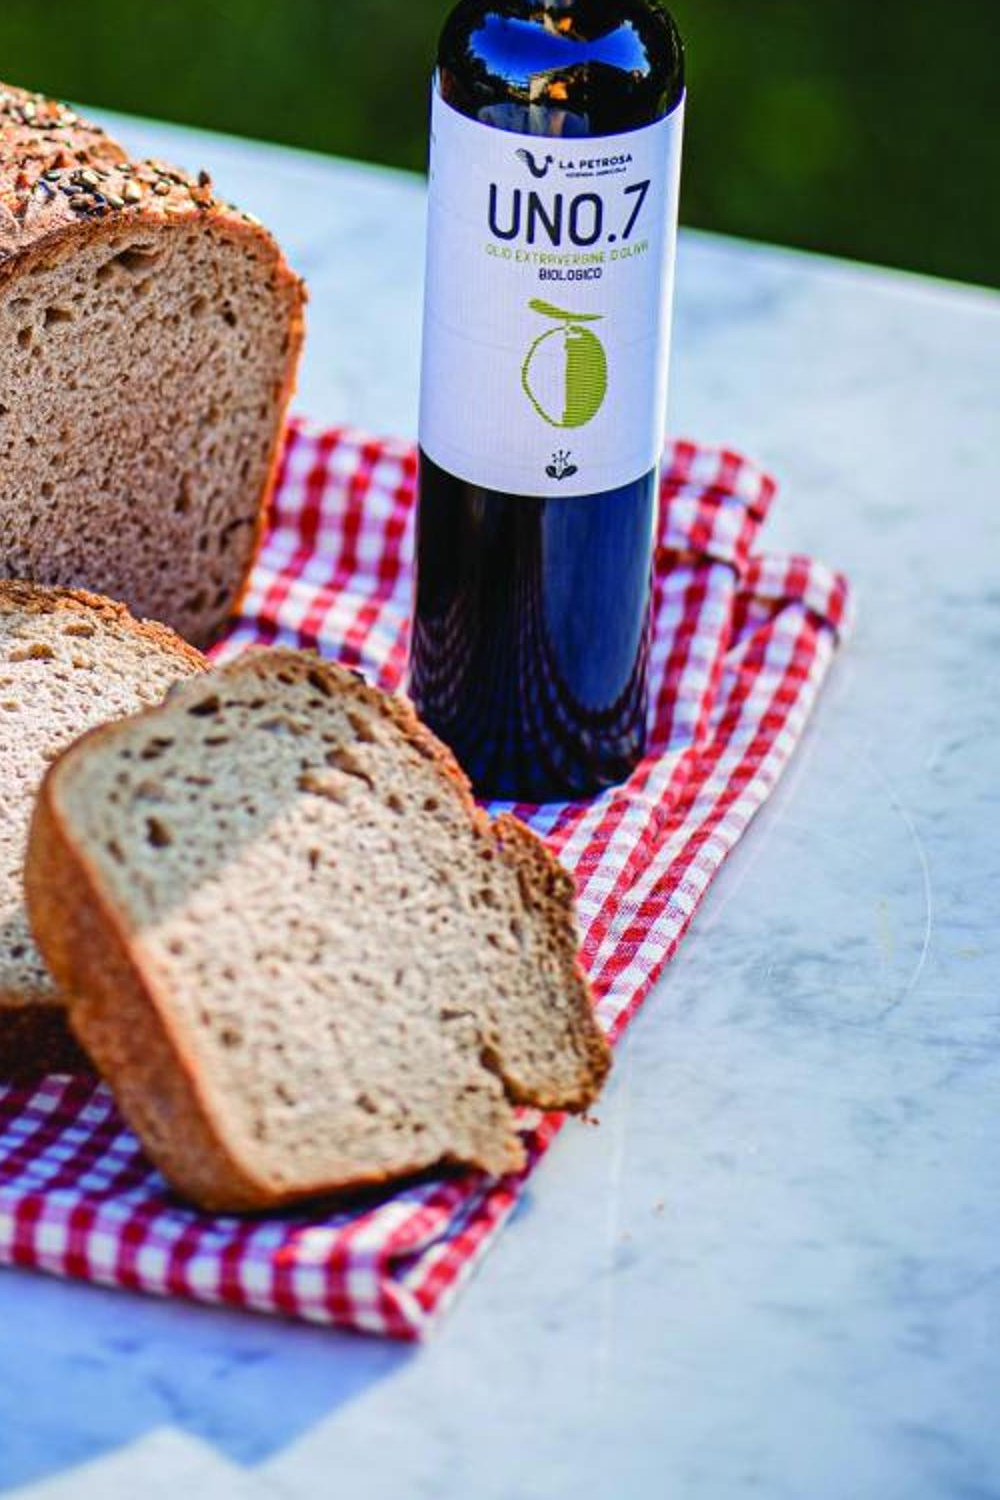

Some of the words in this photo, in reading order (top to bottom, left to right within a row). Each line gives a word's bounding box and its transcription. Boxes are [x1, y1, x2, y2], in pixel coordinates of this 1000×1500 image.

[559, 160, 574, 169] LA
[579, 153, 633, 169] PETROSA
[488, 179, 651, 247] UNO.7
[485, 243, 512, 260] OLIO
[539, 267, 602, 281] BIOLOGICO
